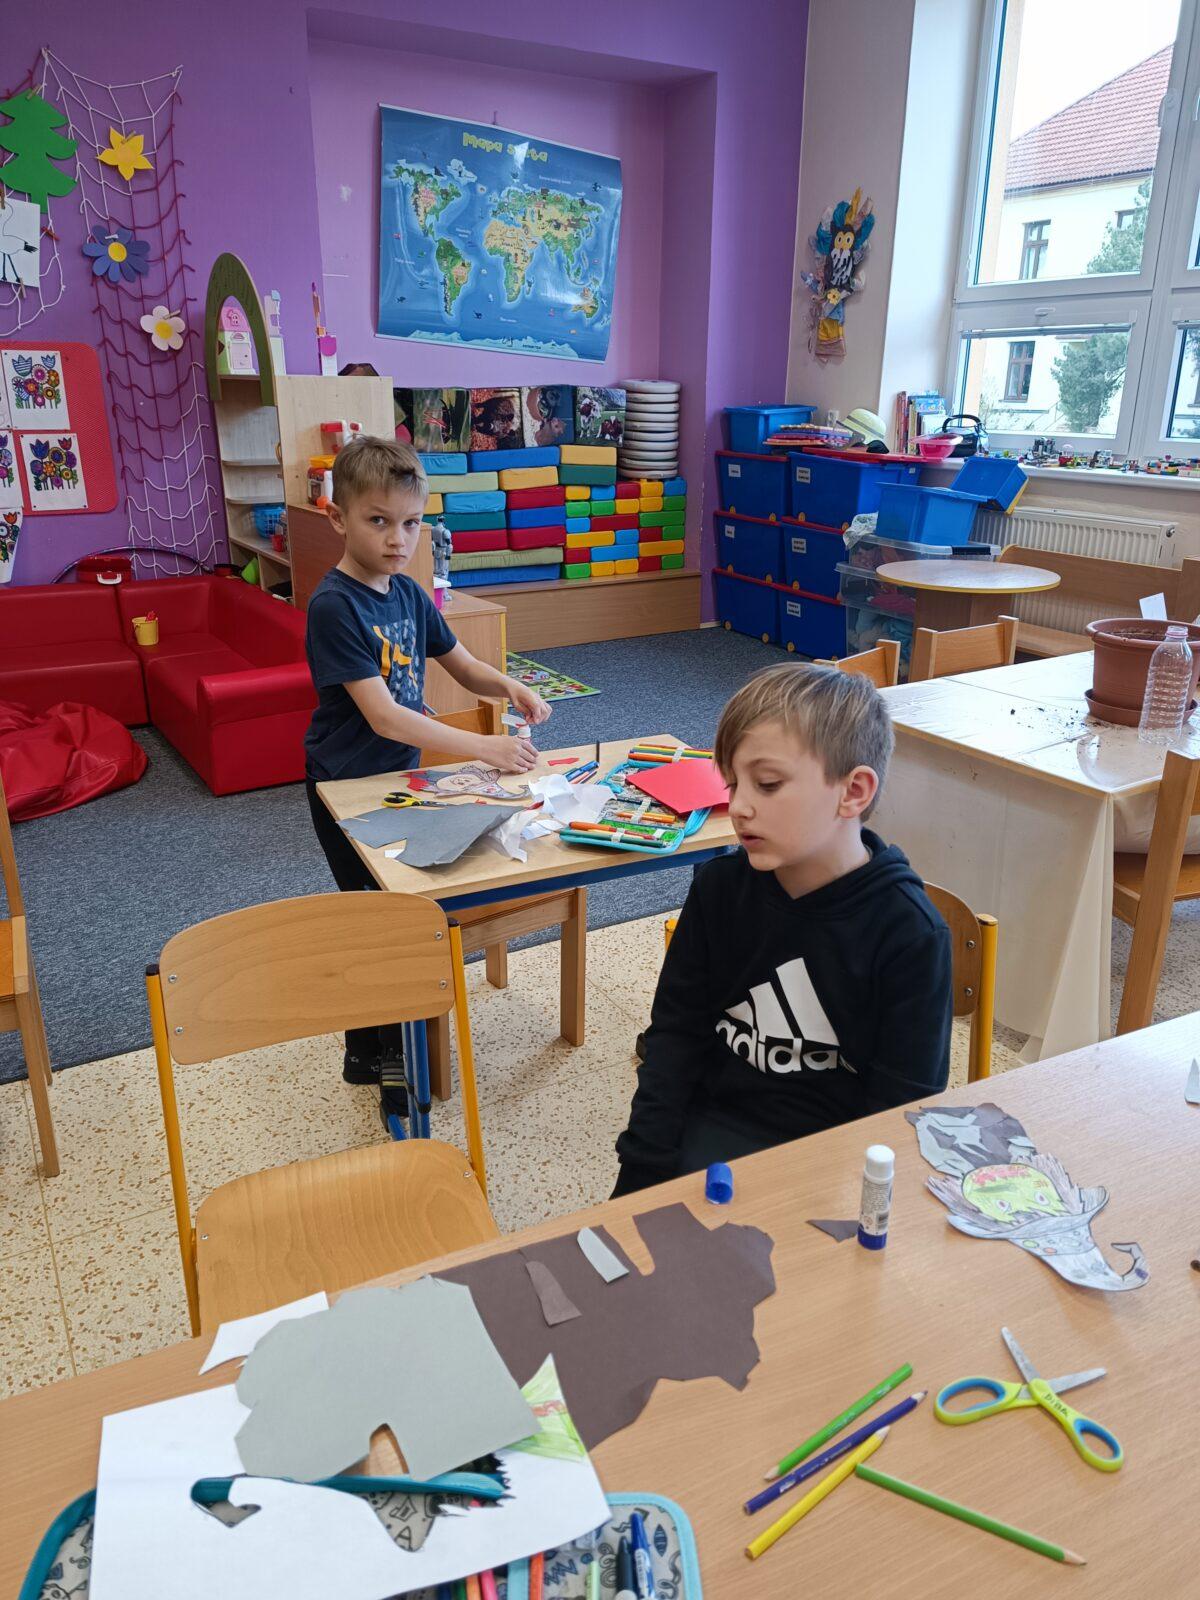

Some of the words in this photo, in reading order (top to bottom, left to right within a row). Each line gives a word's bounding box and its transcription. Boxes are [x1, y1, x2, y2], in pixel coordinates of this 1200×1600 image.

[463, 132, 503, 153] Mapa
[507, 143, 548, 162] sta
[715, 1019, 858, 1074] adida
